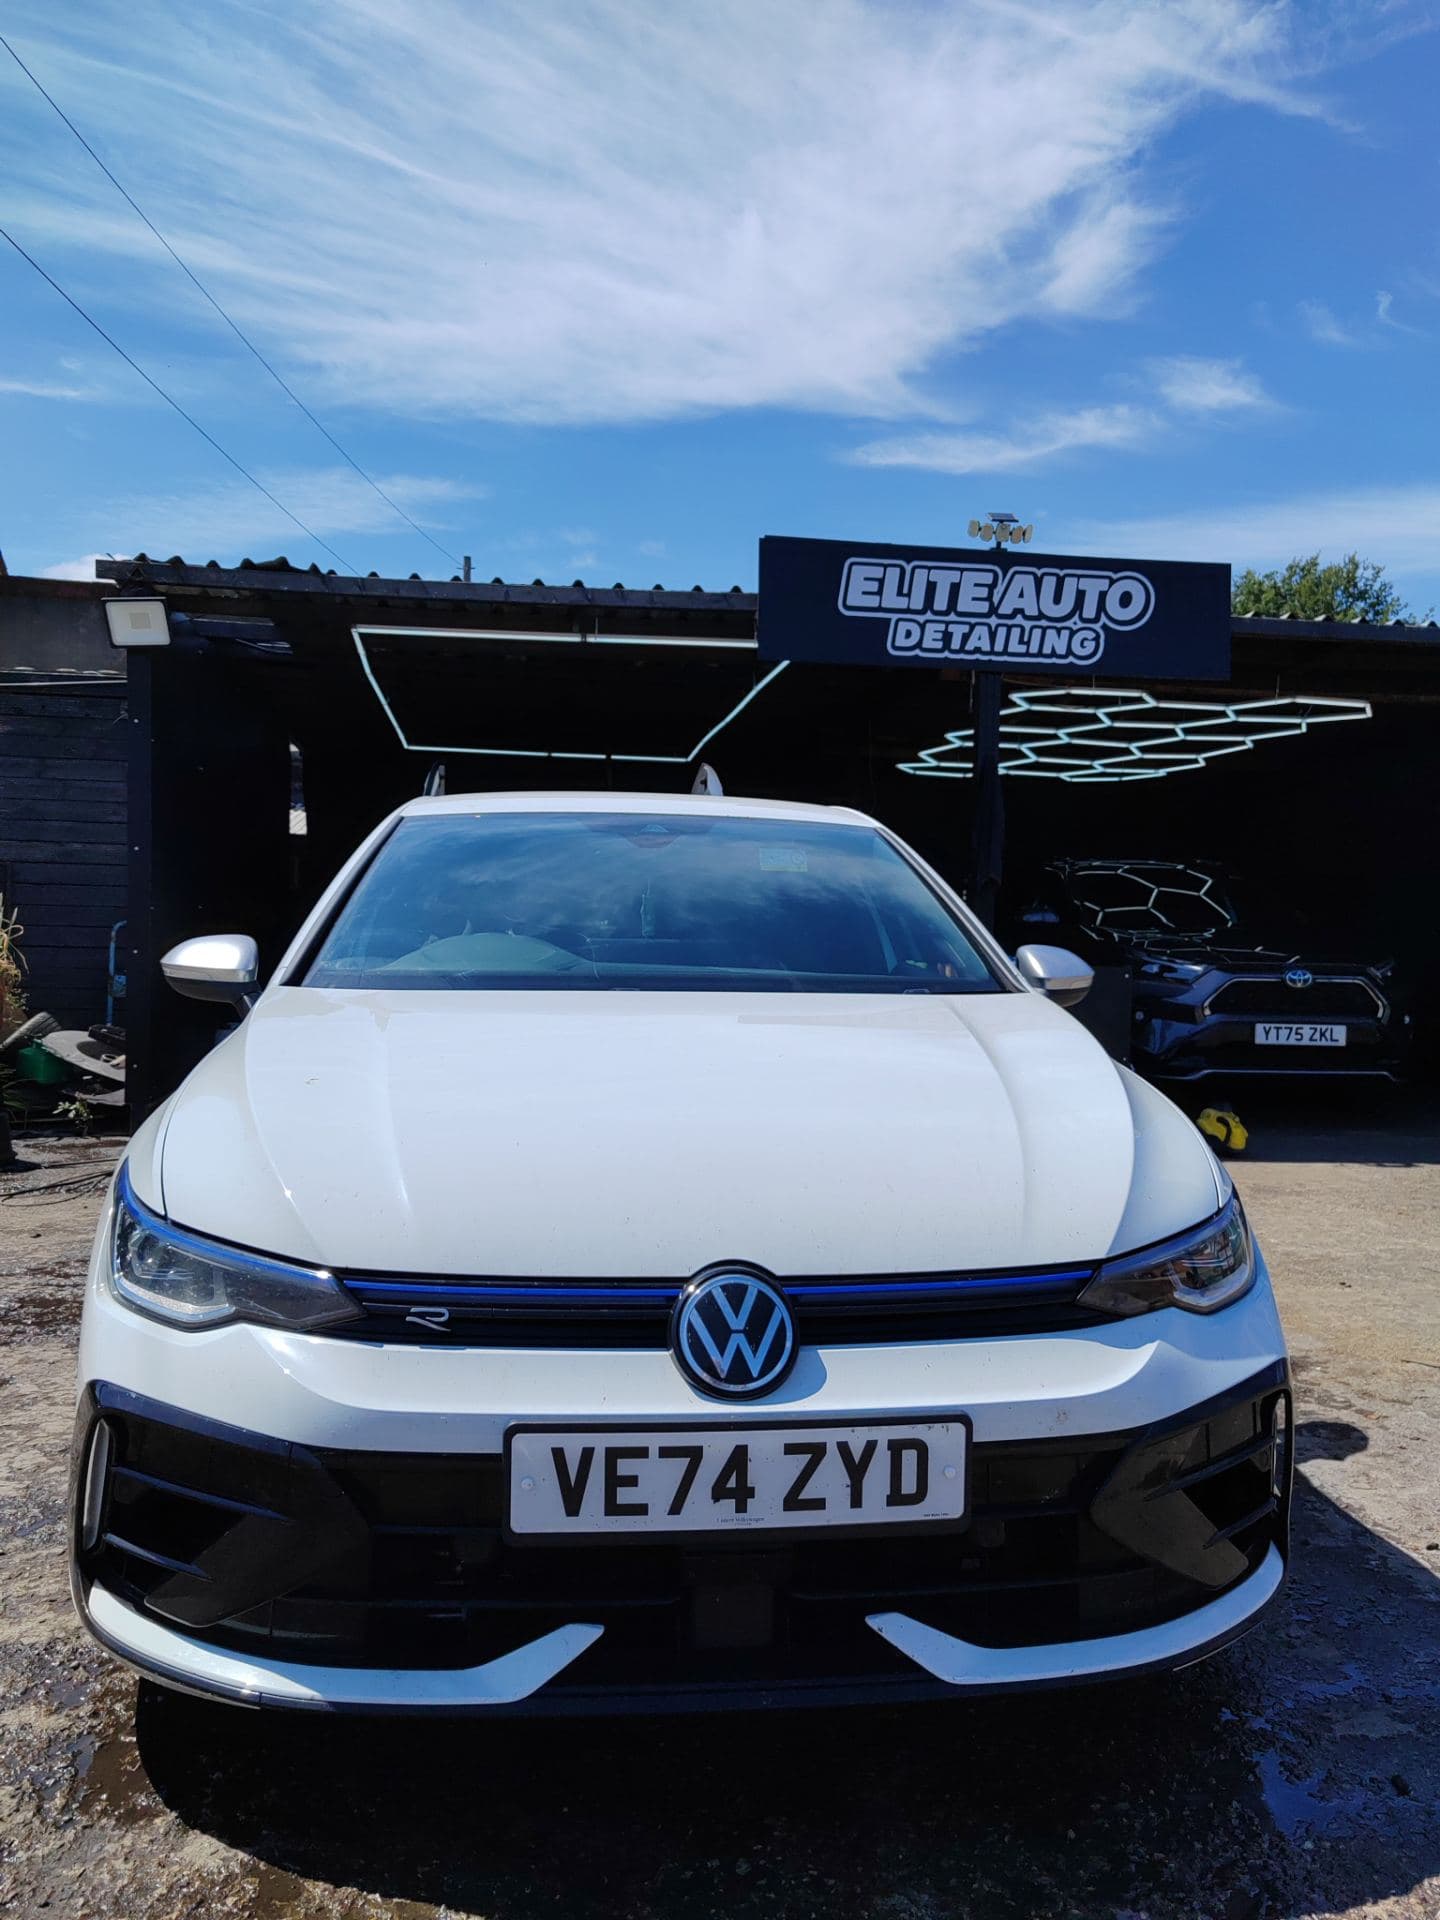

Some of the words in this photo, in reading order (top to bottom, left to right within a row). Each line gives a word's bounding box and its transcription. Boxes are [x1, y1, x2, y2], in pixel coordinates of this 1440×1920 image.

[846, 564, 995, 614] ELITE
[997, 573, 1148, 624] AUTO
[894, 622, 1097, 657] DETAILING
[1263, 1025, 1304, 1042] YT75
[1308, 1026, 1340, 1043] ZKL
[687, 1280, 785, 1382] VW
[550, 1444, 756, 1518] VE74
[782, 1438, 930, 1513] ZYD
